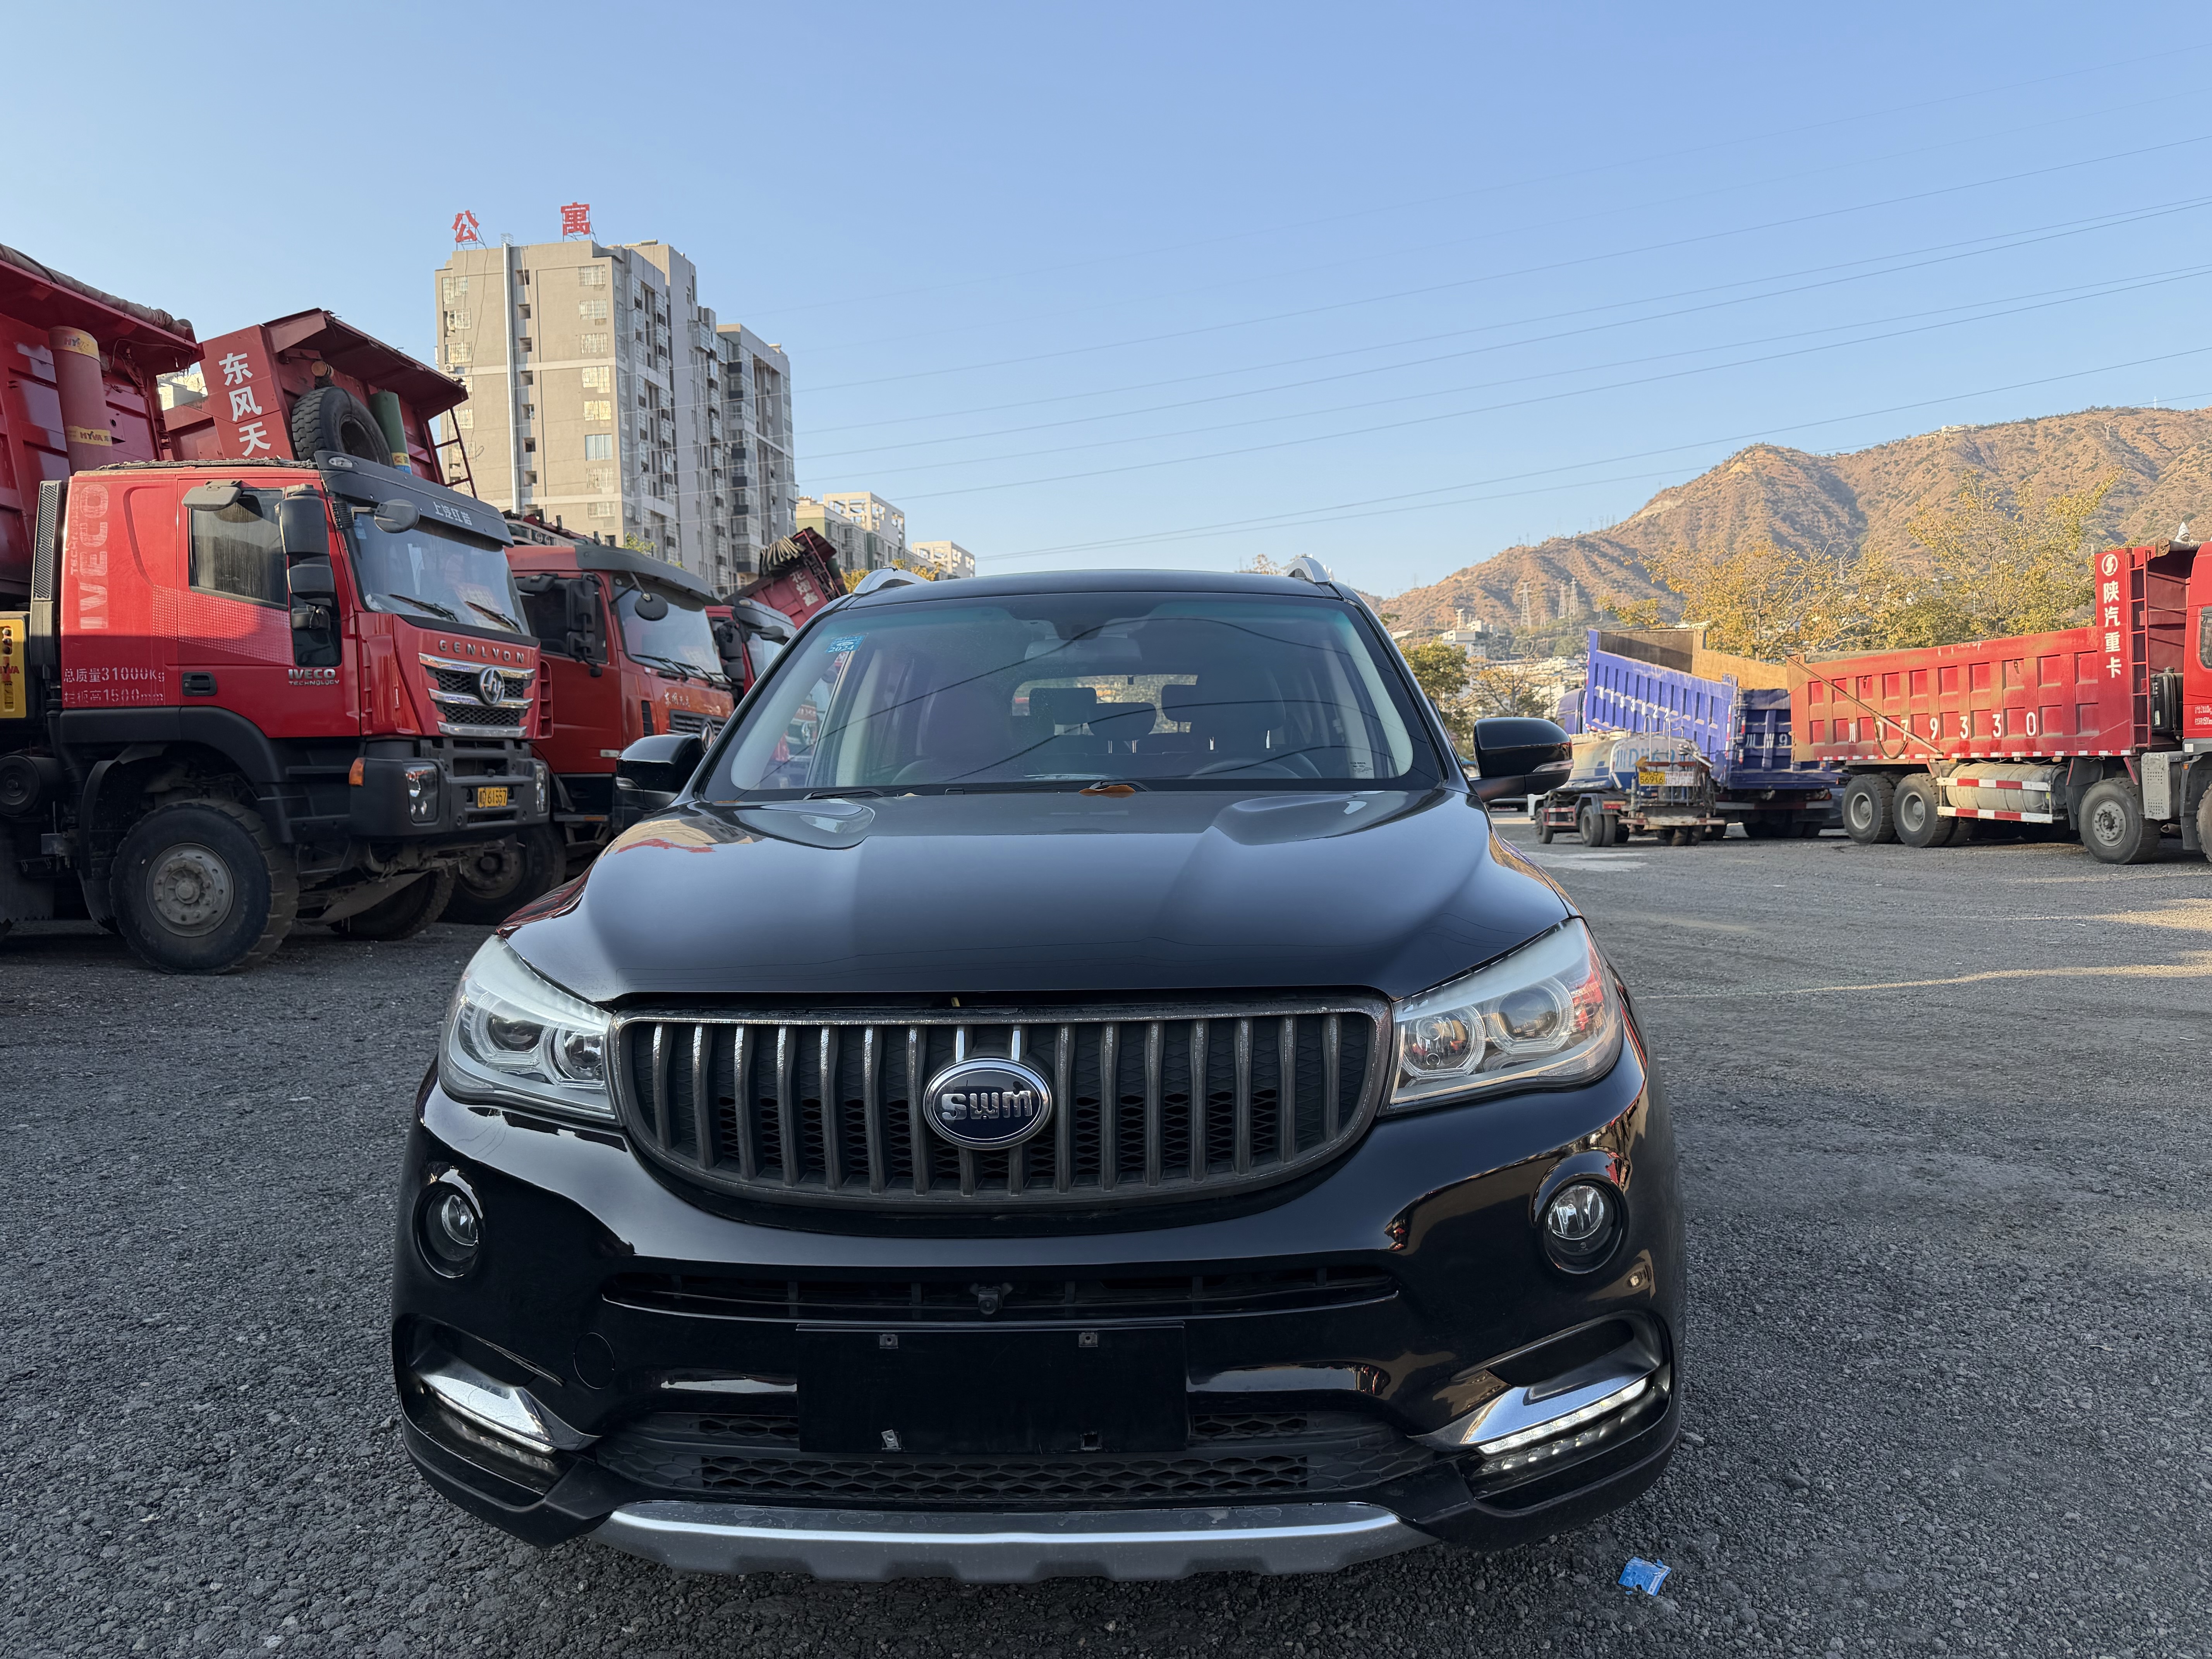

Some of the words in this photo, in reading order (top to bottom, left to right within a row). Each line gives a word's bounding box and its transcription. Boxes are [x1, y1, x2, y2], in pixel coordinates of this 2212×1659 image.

[452, 202, 590, 243] 公寓
[219, 353, 271, 457] 东风天
[80, 431, 103, 441] HYVA
[80, 484, 108, 629] IVECO
[2103, 580, 2122, 678] 陕汽重卡
[440, 640, 524, 663] GENLYON
[288, 669, 336, 679] IVECO
[941, 1090, 1032, 1120] SWM
